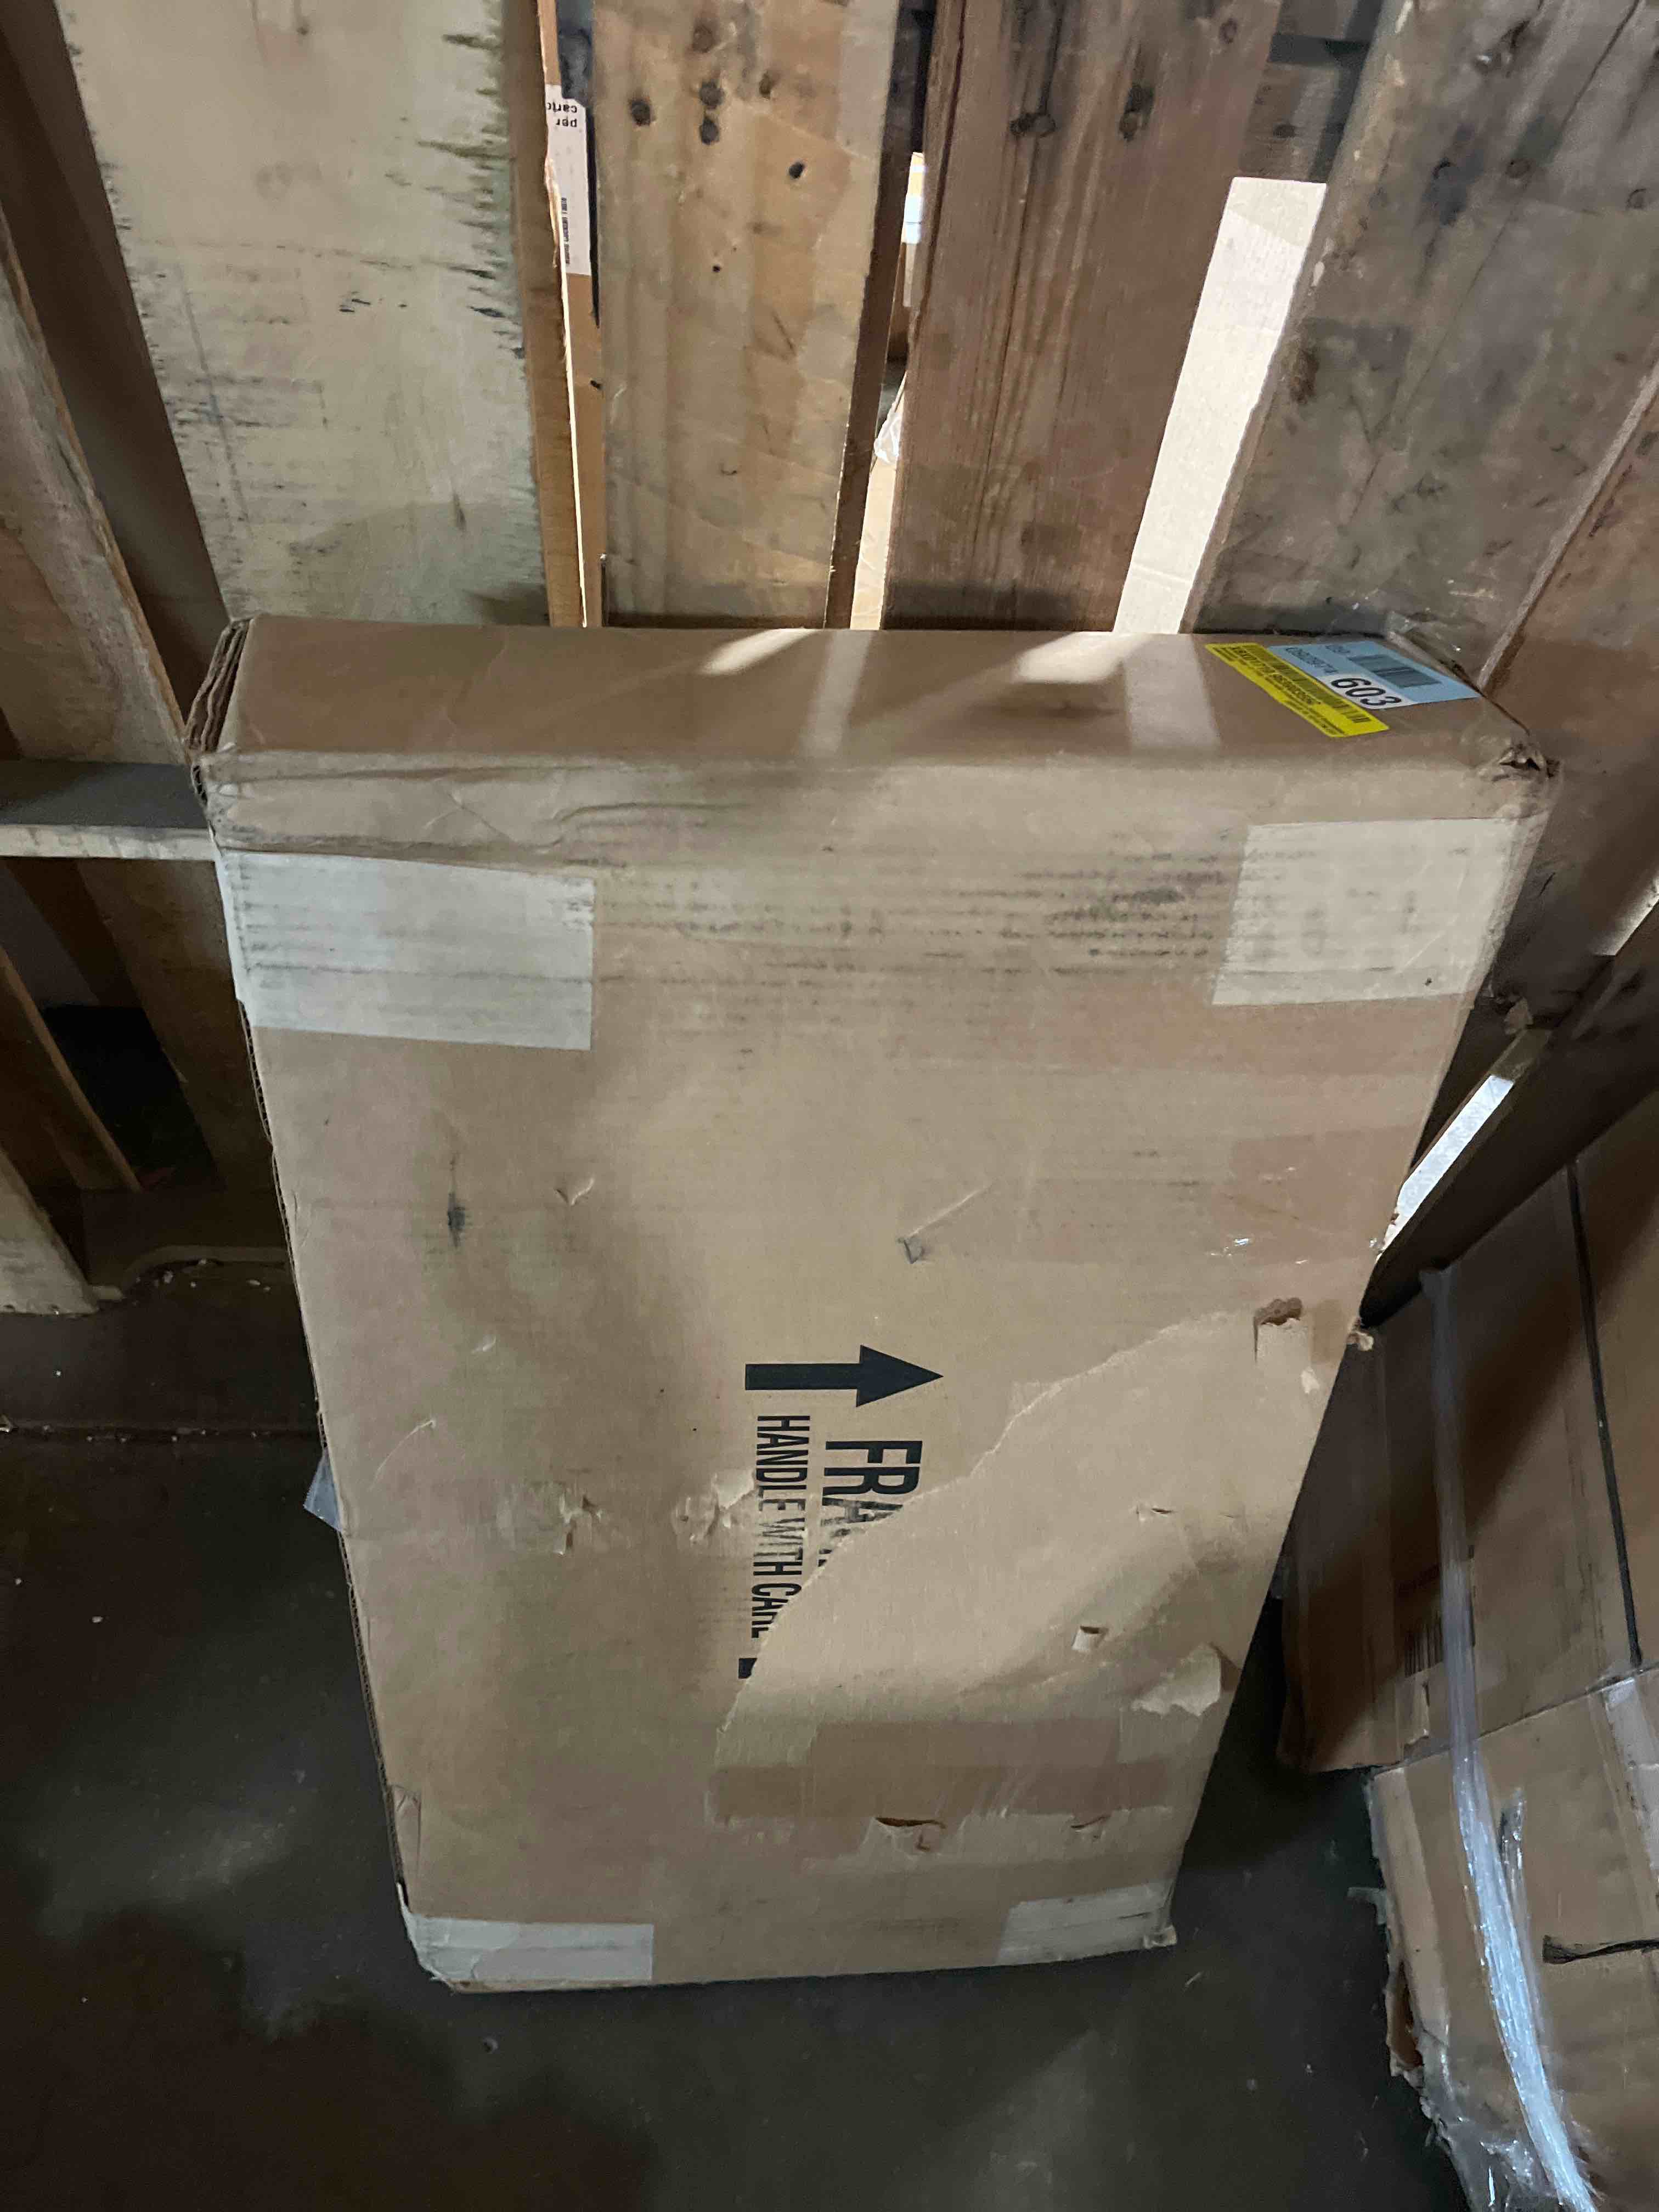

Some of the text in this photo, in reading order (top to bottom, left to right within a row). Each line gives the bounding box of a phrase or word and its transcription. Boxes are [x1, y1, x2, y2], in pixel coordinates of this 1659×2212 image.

[556, 117, 578, 128] per
[1330, 677, 1402, 707] 603
[755, 1415, 810, 1511] HANDLE
[753, 1517, 805, 1576] WITH
